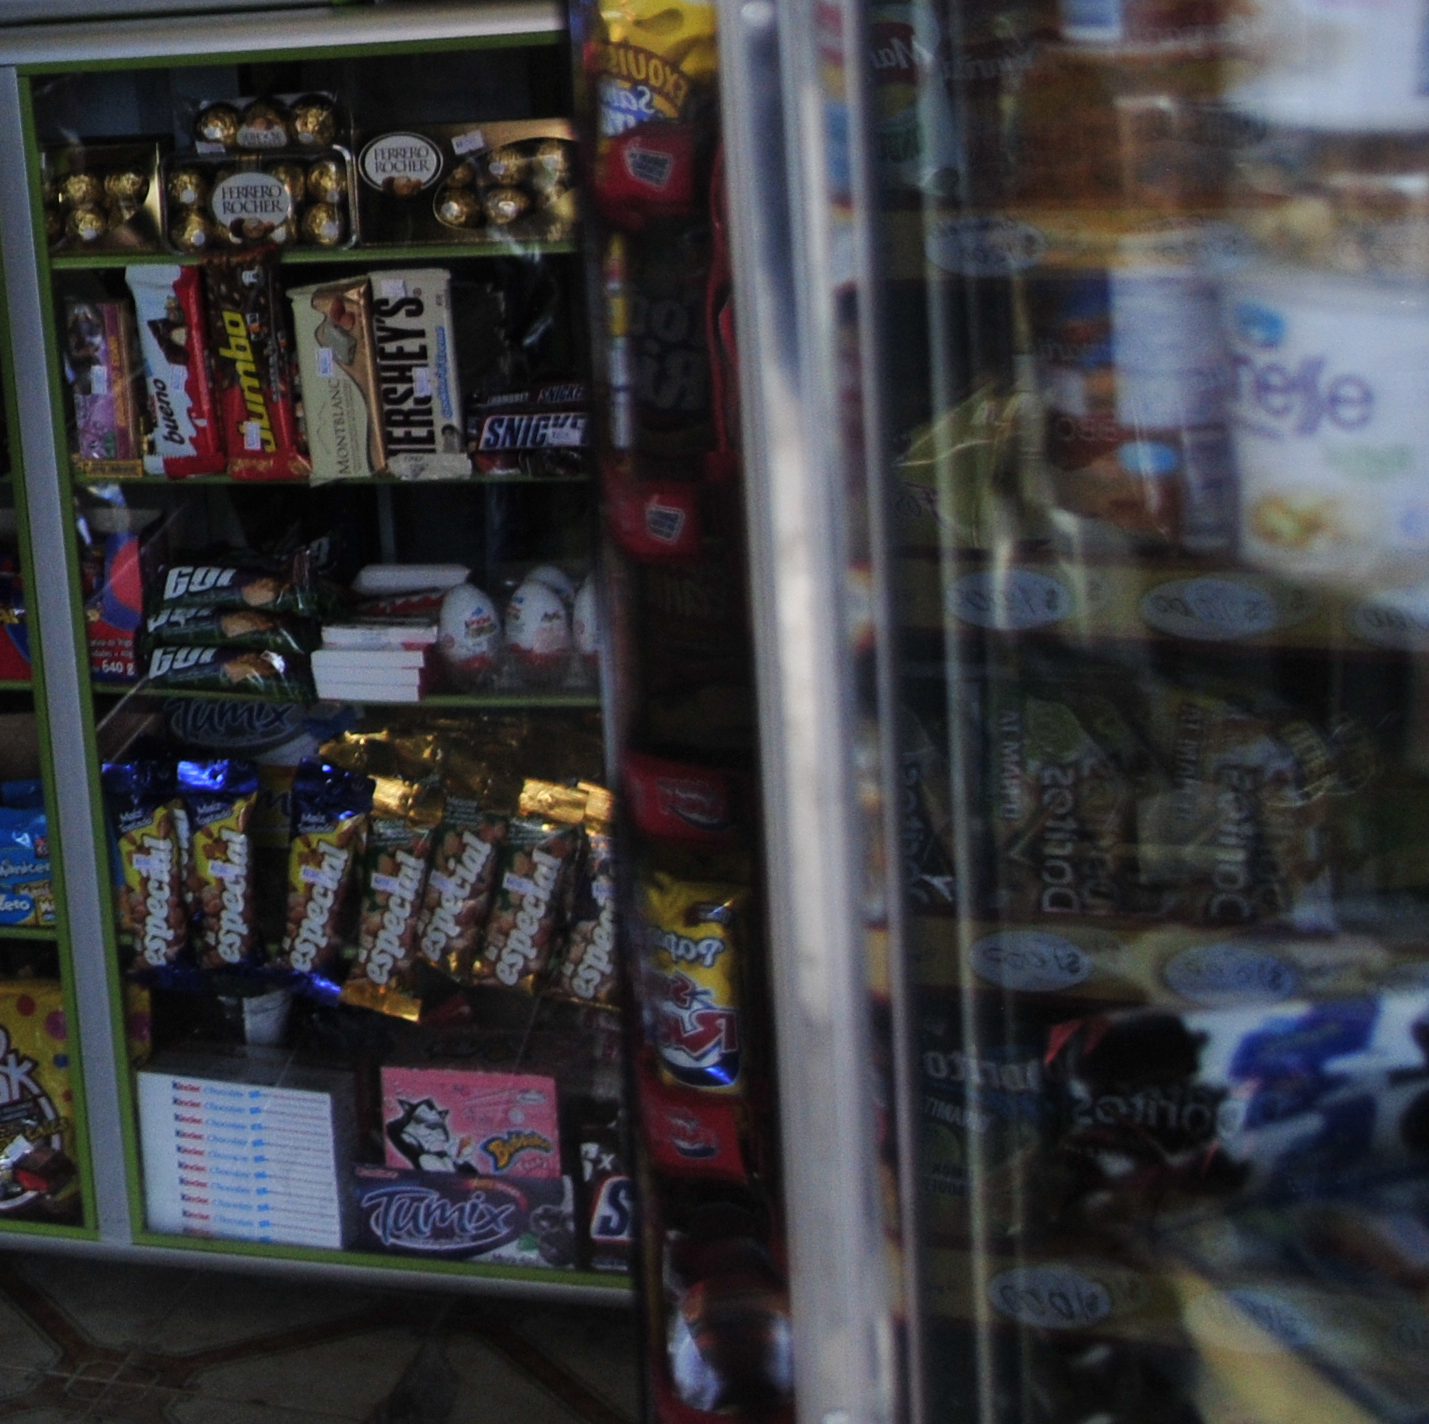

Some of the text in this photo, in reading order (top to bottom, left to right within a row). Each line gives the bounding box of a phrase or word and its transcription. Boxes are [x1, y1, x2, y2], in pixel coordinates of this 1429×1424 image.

[373, 145, 429, 162] FERRERO
[374, 159, 430, 175] ROCHER
[220, 184, 283, 203] FERRERO
[222, 197, 281, 217] ROCHER
[152, 378, 187, 446] bueno
[219, 309, 278, 454] Jumbo
[365, 849, 426, 985] especial
[420, 829, 493, 962] especial
[495, 845, 561, 987] especial
[360, 1184, 514, 1246] Tumix
